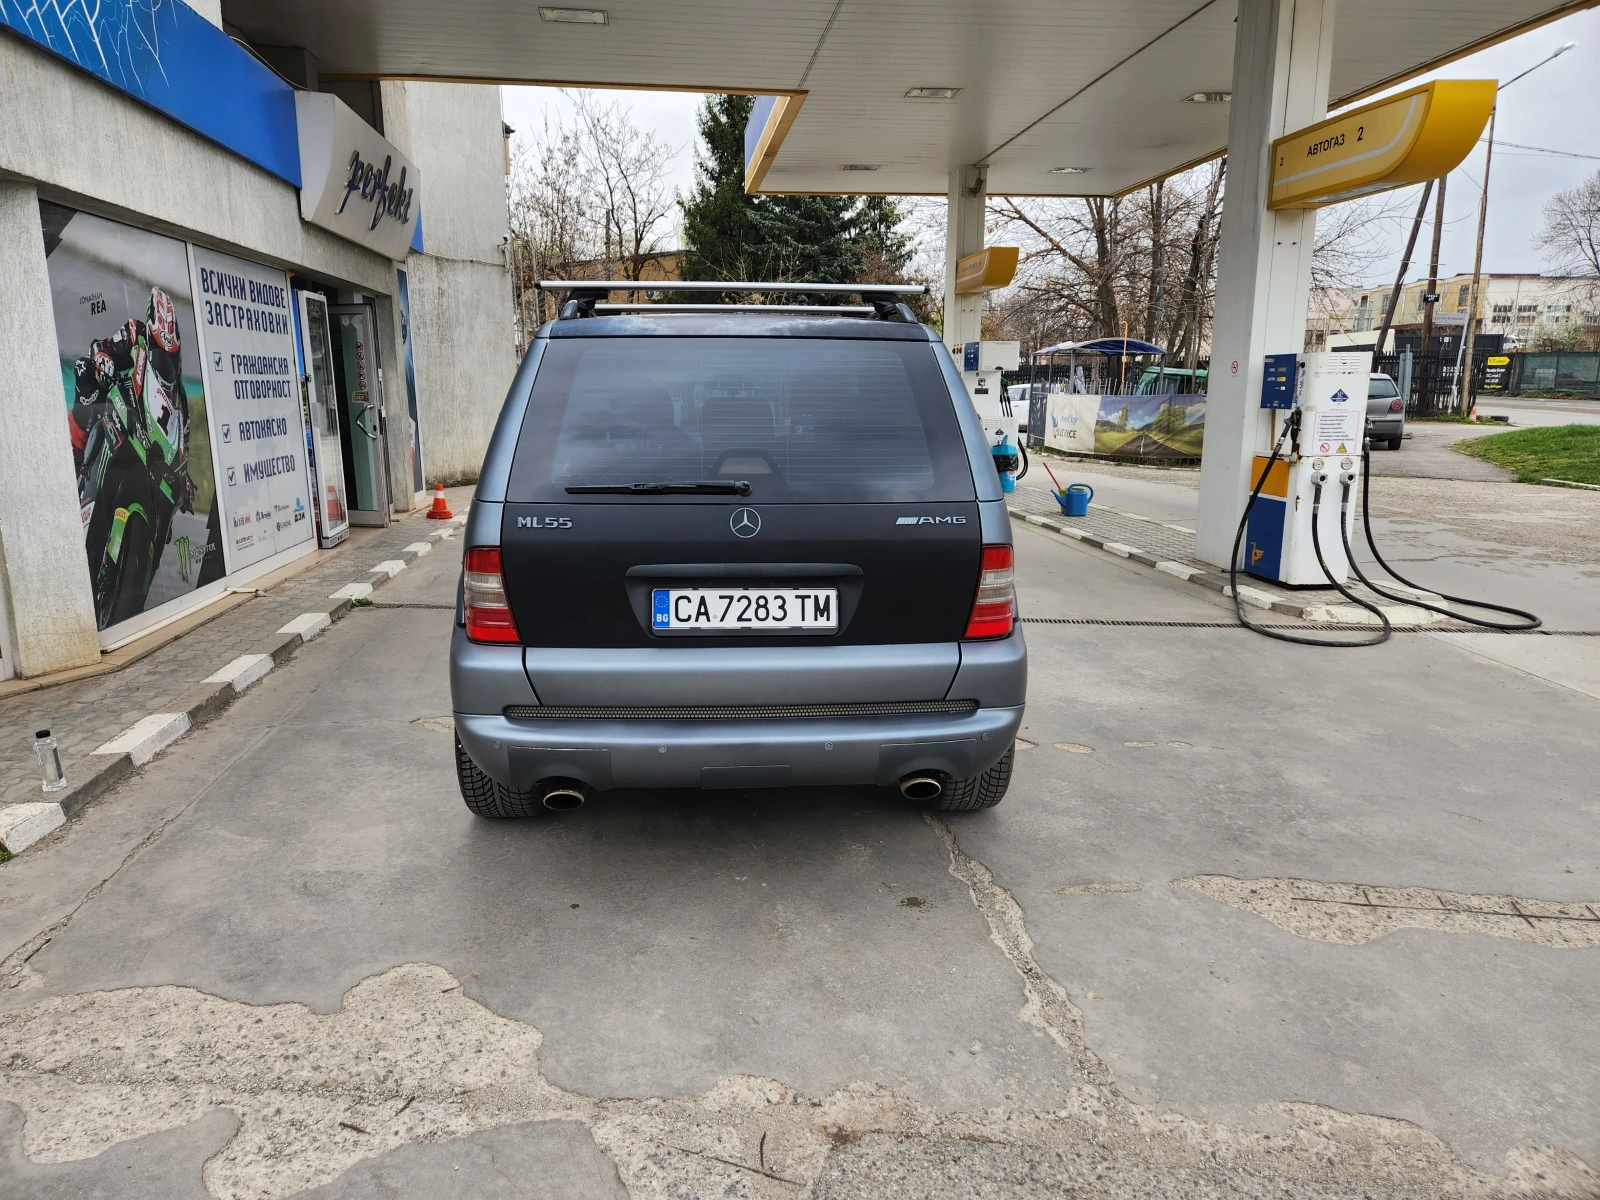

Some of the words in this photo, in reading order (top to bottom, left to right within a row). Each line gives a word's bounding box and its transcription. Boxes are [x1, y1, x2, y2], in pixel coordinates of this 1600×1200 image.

[1279, 157, 1284, 167] 2
[1306, 133, 1345, 157] АВТОГАЗ
[1357, 126, 1364, 142] 2
[334, 149, 414, 232] perfekt
[79, 291, 104, 305] JONATHAN
[200, 266, 248, 302] ВСИЧКИ
[248, 279, 287, 310] ВИДОВЕ
[90, 299, 108, 316] REA
[204, 299, 290, 336] ЗАСТРАХОВКИ
[230, 353, 290, 376] ГРАЖДАНСКА
[233, 379, 292, 400] ОТГОВОРНОСТ
[238, 417, 288, 442] АВТОКАСКО
[243, 454, 296, 483] ИМУЩЕСТВО
[517, 516, 573, 529] ML55
[918, 516, 967, 525] AMG
[656, 614, 669, 623] BG
[674, 595, 711, 622] CA
[718, 594, 788, 622] 7283
[794, 594, 831, 622] TM
